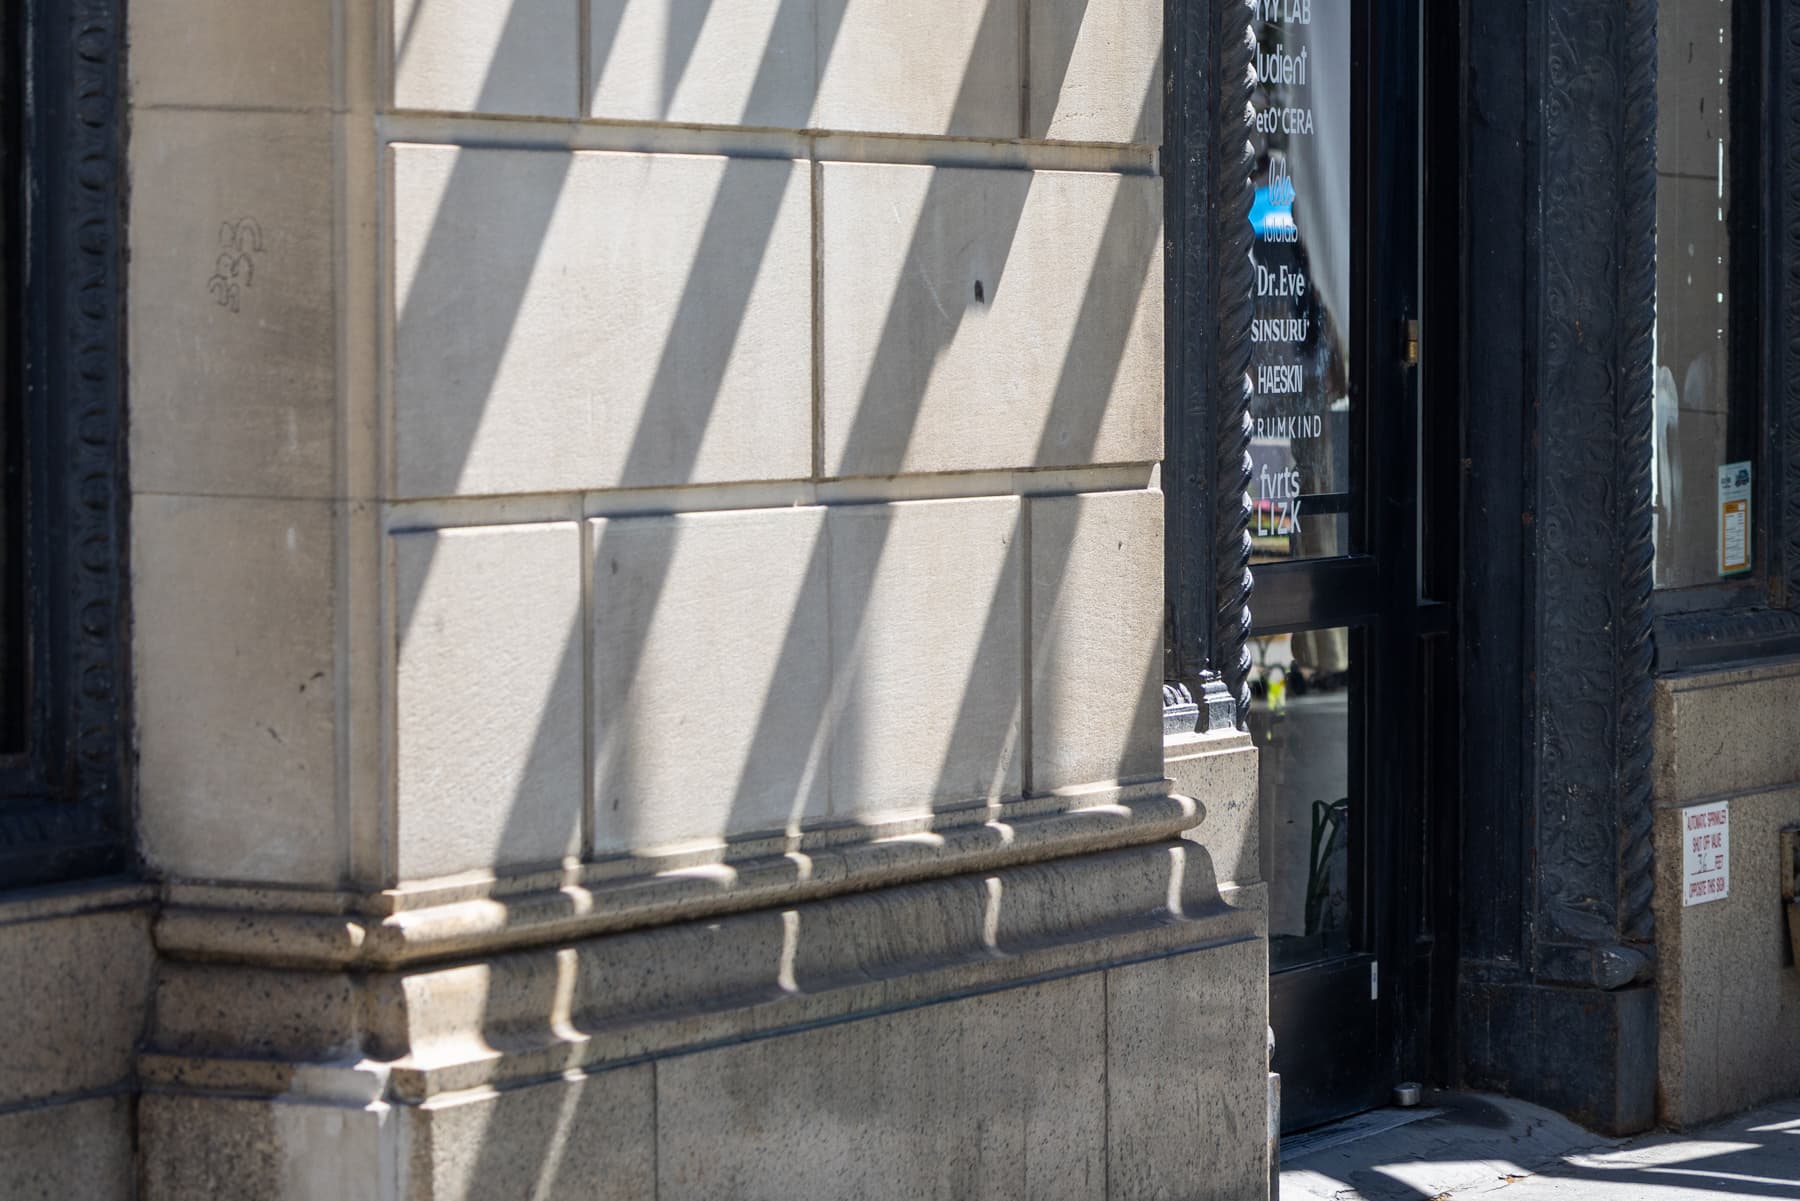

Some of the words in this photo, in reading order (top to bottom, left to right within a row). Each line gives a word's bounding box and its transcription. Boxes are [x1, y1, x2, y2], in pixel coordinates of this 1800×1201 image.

[1257, 265, 1305, 297] Dr.Eve
[1258, 365, 1303, 394] HAESKN
[1252, 415, 1322, 440] RUMKIND
[1260, 464, 1300, 499] fvrts
[1258, 500, 1302, 537] LIZK
